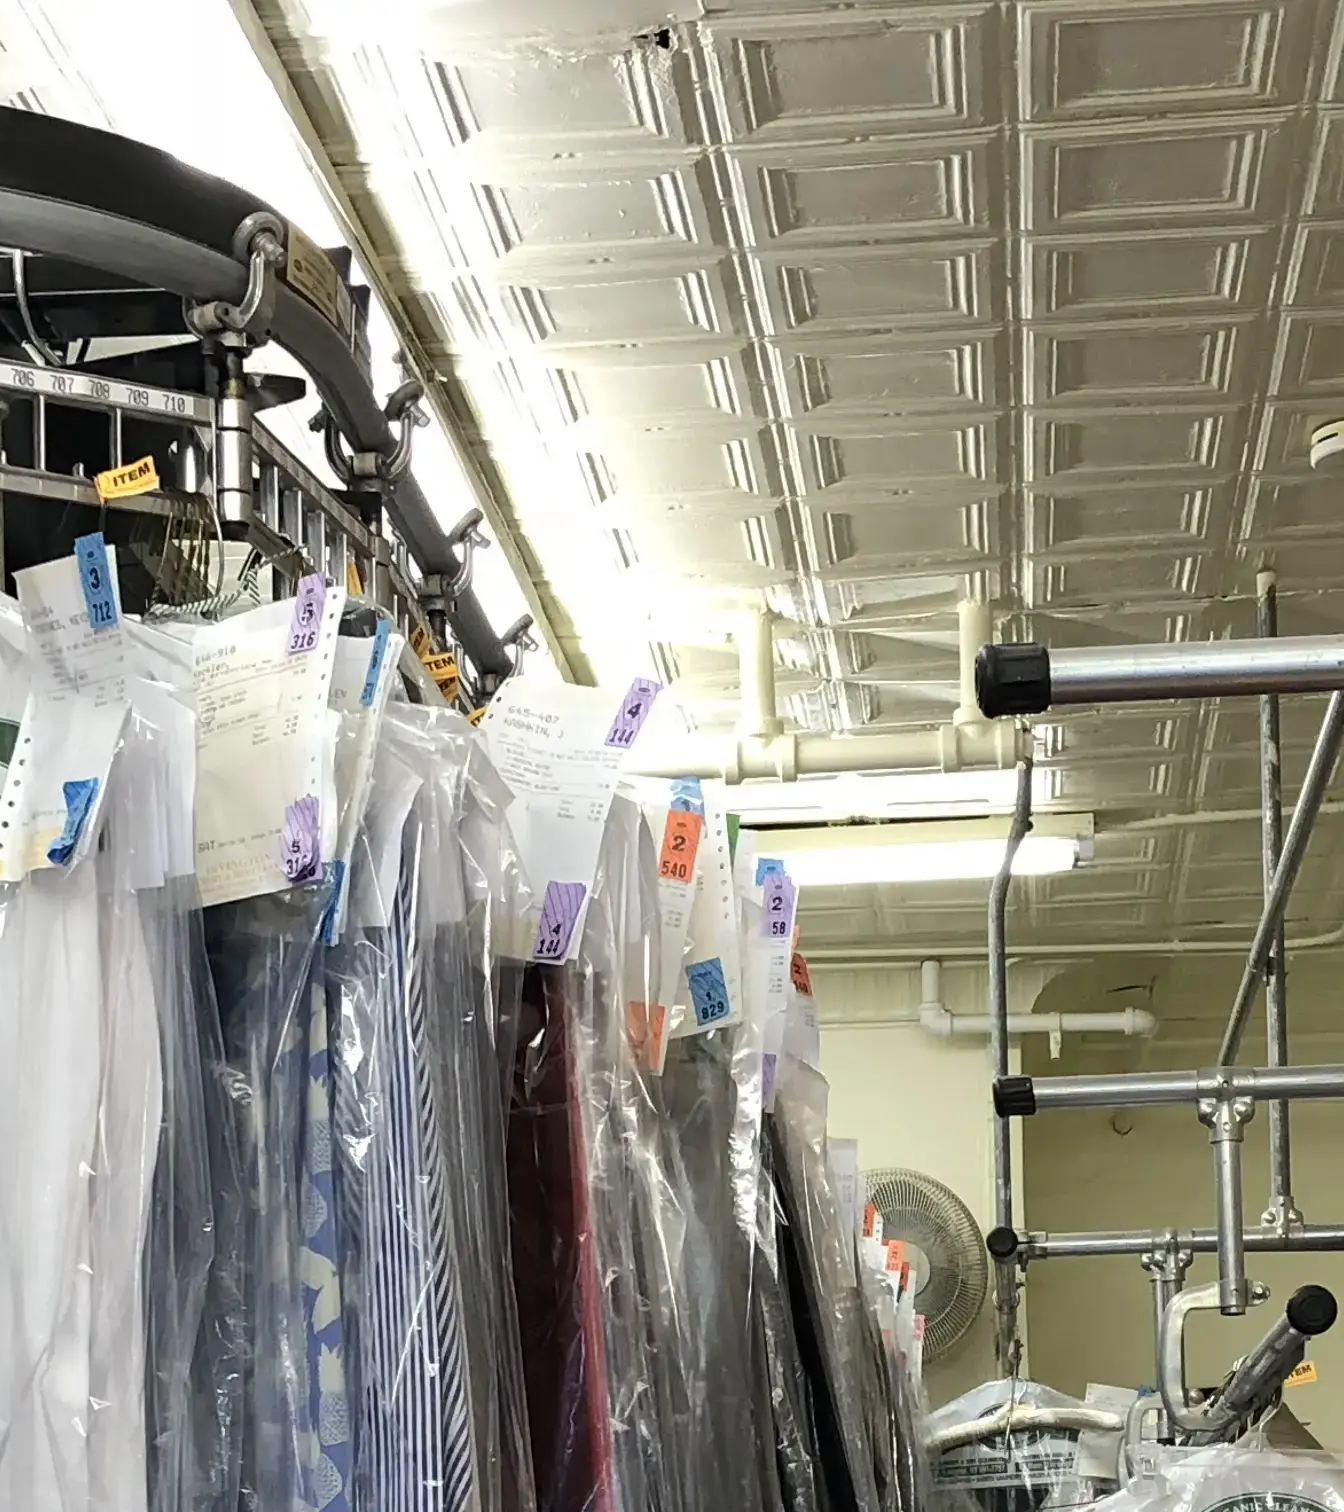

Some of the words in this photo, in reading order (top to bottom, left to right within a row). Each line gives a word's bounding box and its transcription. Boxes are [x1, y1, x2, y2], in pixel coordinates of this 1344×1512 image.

[11, 367, 35, 387] 706
[50, 374, 74, 393] 707
[88, 380, 110, 399] 708
[126, 388, 149, 406] 709
[162, 394, 185, 413] 710
[112, 462, 150, 488] ITEM
[89, 567, 101, 590] 3
[92, 600, 113, 623] 712
[290, 630, 316, 650] 316
[608, 728, 635, 745] 144
[671, 835, 686, 852] 2
[661, 860, 687, 878] 540
[771, 896, 784, 911] 2
[536, 939, 561, 955] 144
[701, 1004, 725, 1020] 829
